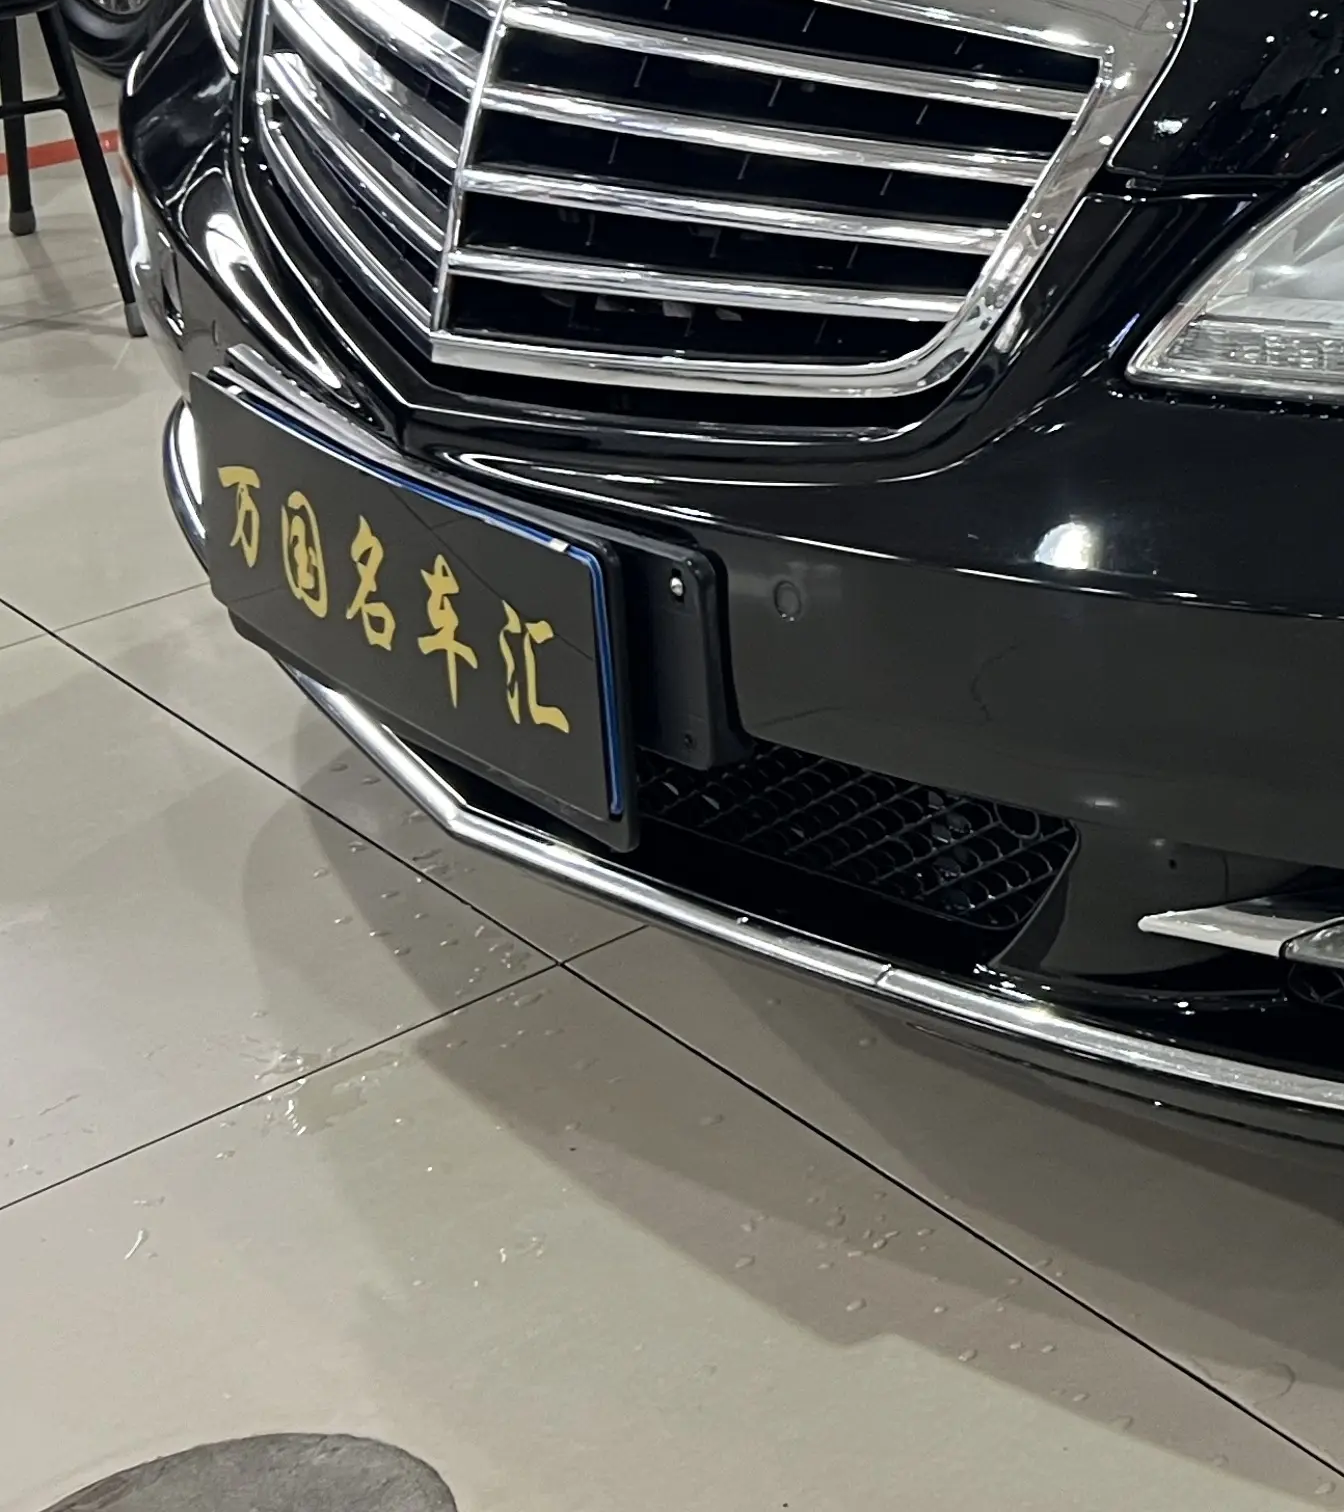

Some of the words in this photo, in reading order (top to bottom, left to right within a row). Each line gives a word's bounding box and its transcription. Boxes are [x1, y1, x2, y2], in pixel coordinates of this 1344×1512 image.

[216, 464, 571, 734] 万国名车汇
